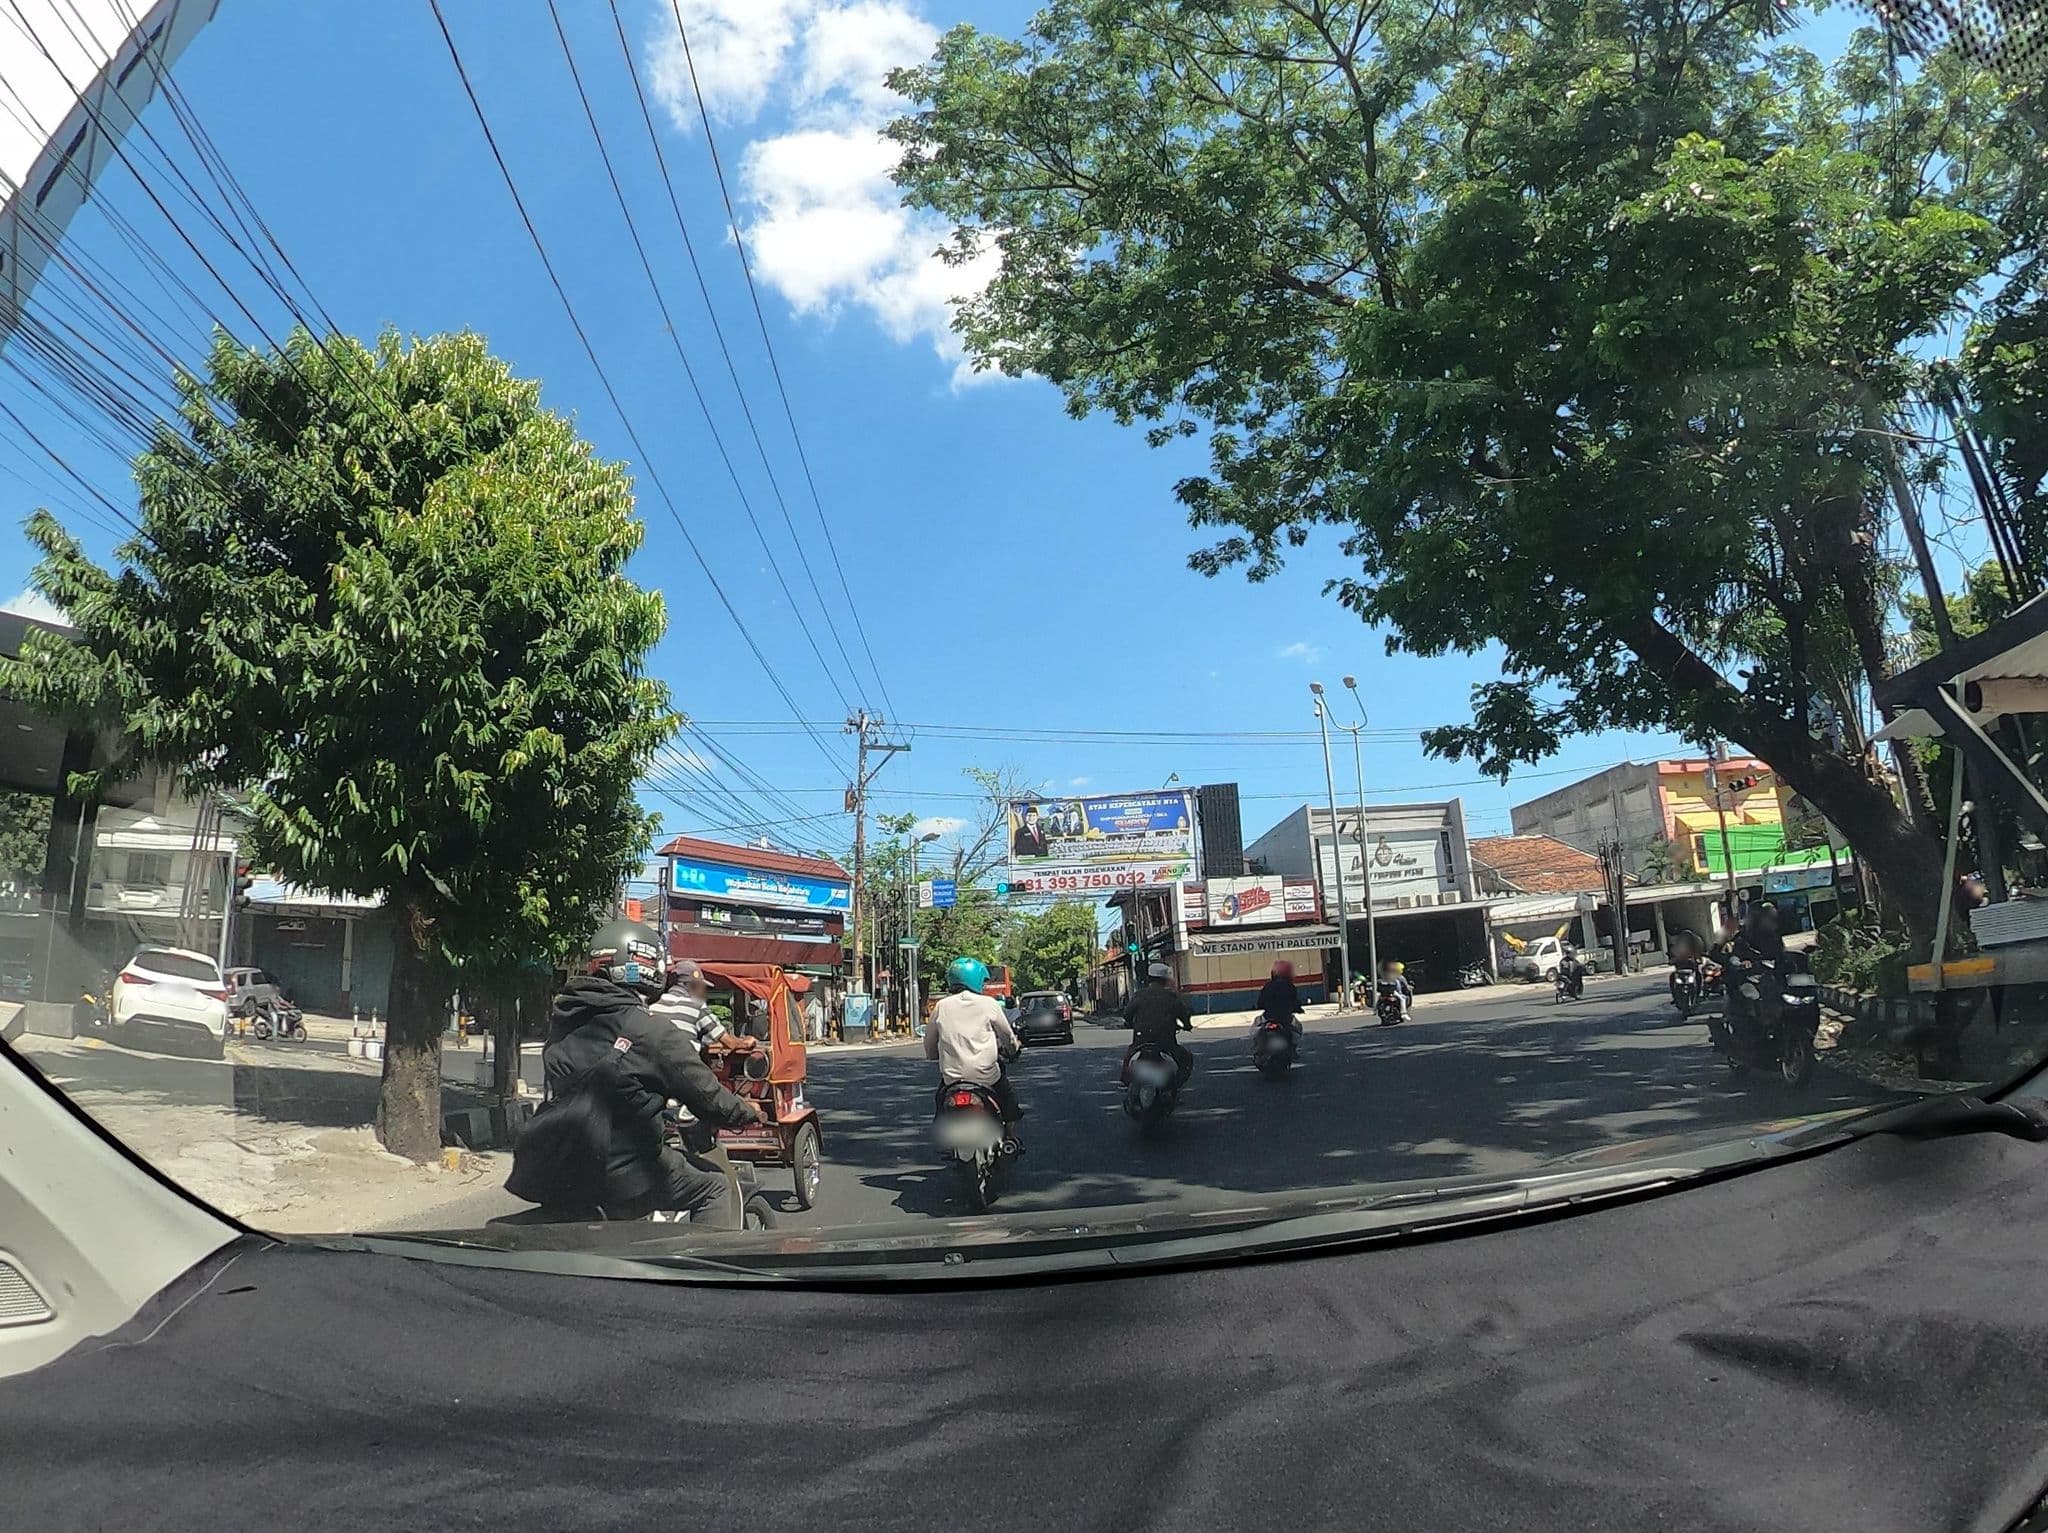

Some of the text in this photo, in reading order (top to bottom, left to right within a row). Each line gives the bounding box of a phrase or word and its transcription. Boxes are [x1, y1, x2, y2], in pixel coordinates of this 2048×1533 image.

[1033, 869, 1060, 877] TEMPAT
[1083, 865, 1126, 874] DISEWAKAN
[1048, 876, 1077, 889] 393
[1082, 873, 1111, 888] 750
[1116, 871, 1146, 885] 032
[1201, 944, 1217, 953] WE
[1219, 941, 1254, 952] STAND
[1257, 940, 1284, 950] WITH
[1286, 936, 1339, 947] PALESTINE
